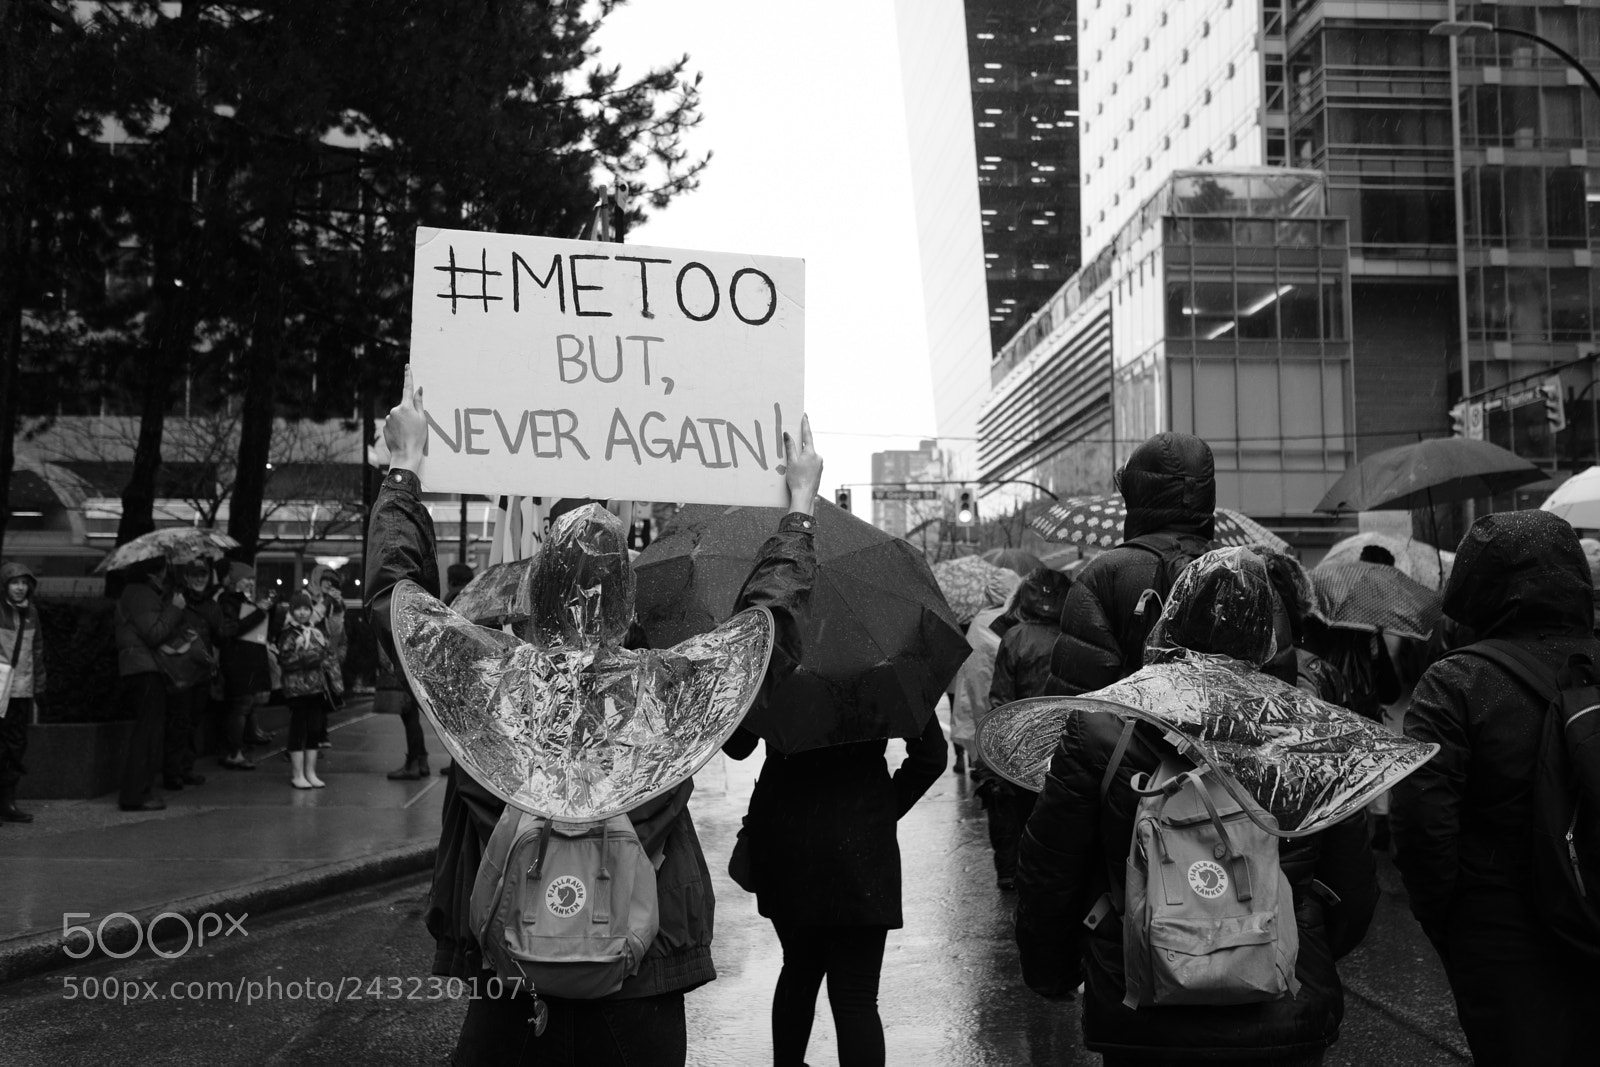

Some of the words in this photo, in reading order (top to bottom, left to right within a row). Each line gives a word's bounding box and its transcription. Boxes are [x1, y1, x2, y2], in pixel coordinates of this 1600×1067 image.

[434, 245, 778, 326] #METOO
[556, 333, 675, 396] BUT,
[423, 407, 590, 461] NEVER
[604, 402, 788, 477] AGAIN!
